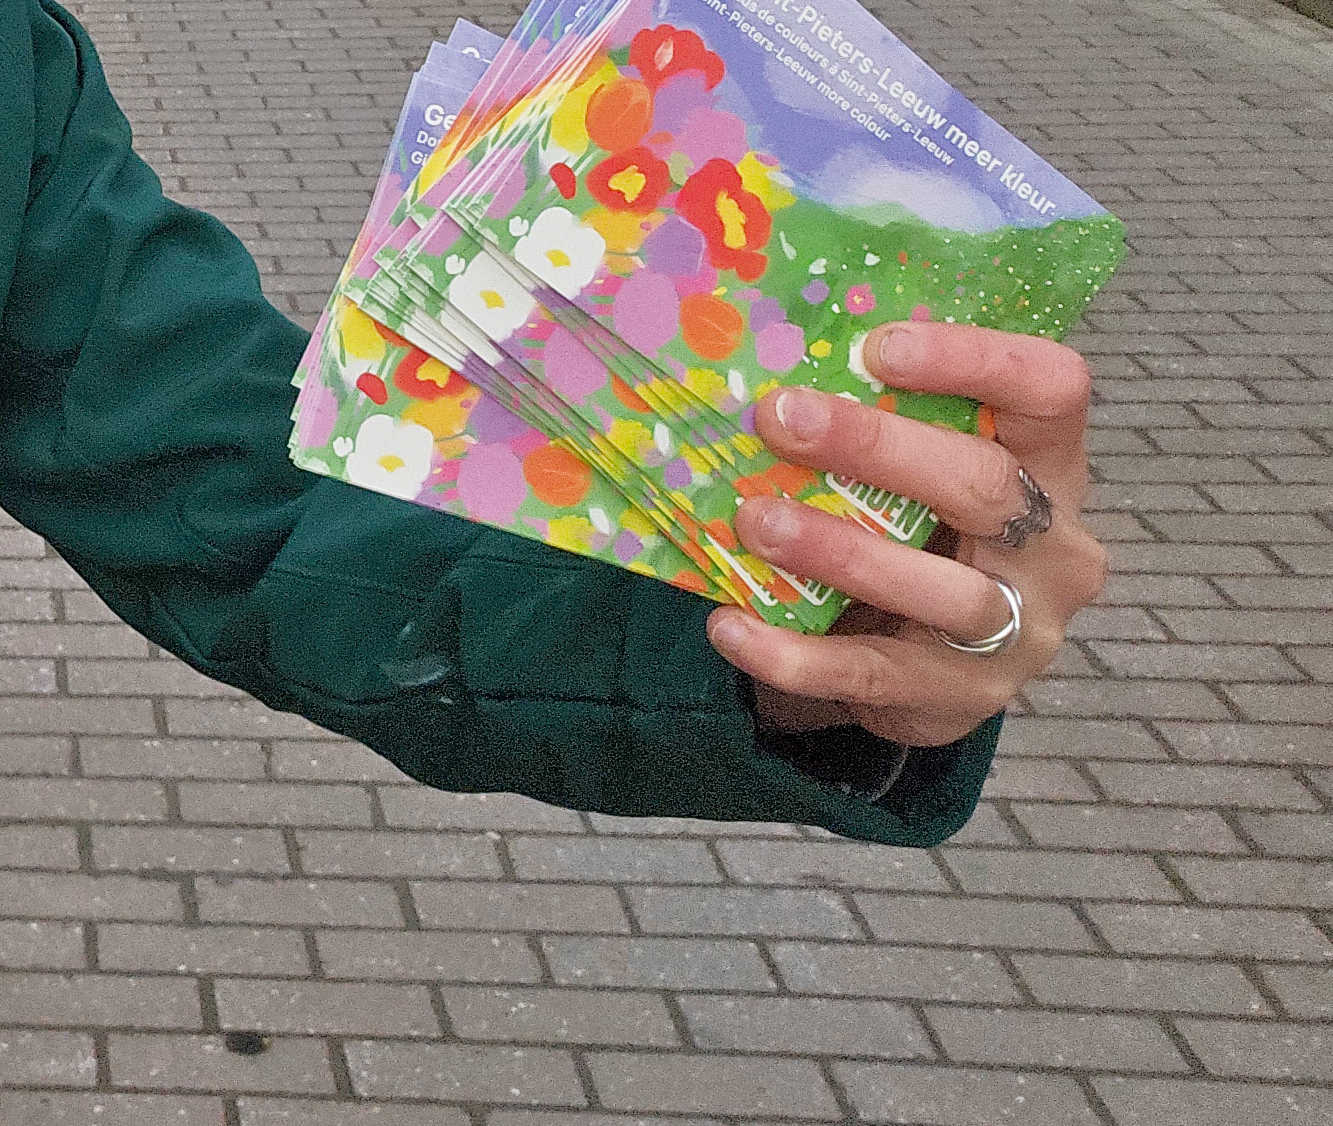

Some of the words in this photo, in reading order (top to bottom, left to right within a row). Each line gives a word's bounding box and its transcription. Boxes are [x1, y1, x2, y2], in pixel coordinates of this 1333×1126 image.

[757, 8, 775, 26] de
[774, 22, 829, 69] couleurs
[838, 69, 955, 166] Sint-Pieters-Leeuw
[816, 81, 851, 111] more
[849, 107, 892, 142] colour
[424, 104, 458, 130] Ge
[944, 124, 1003, 172] meer
